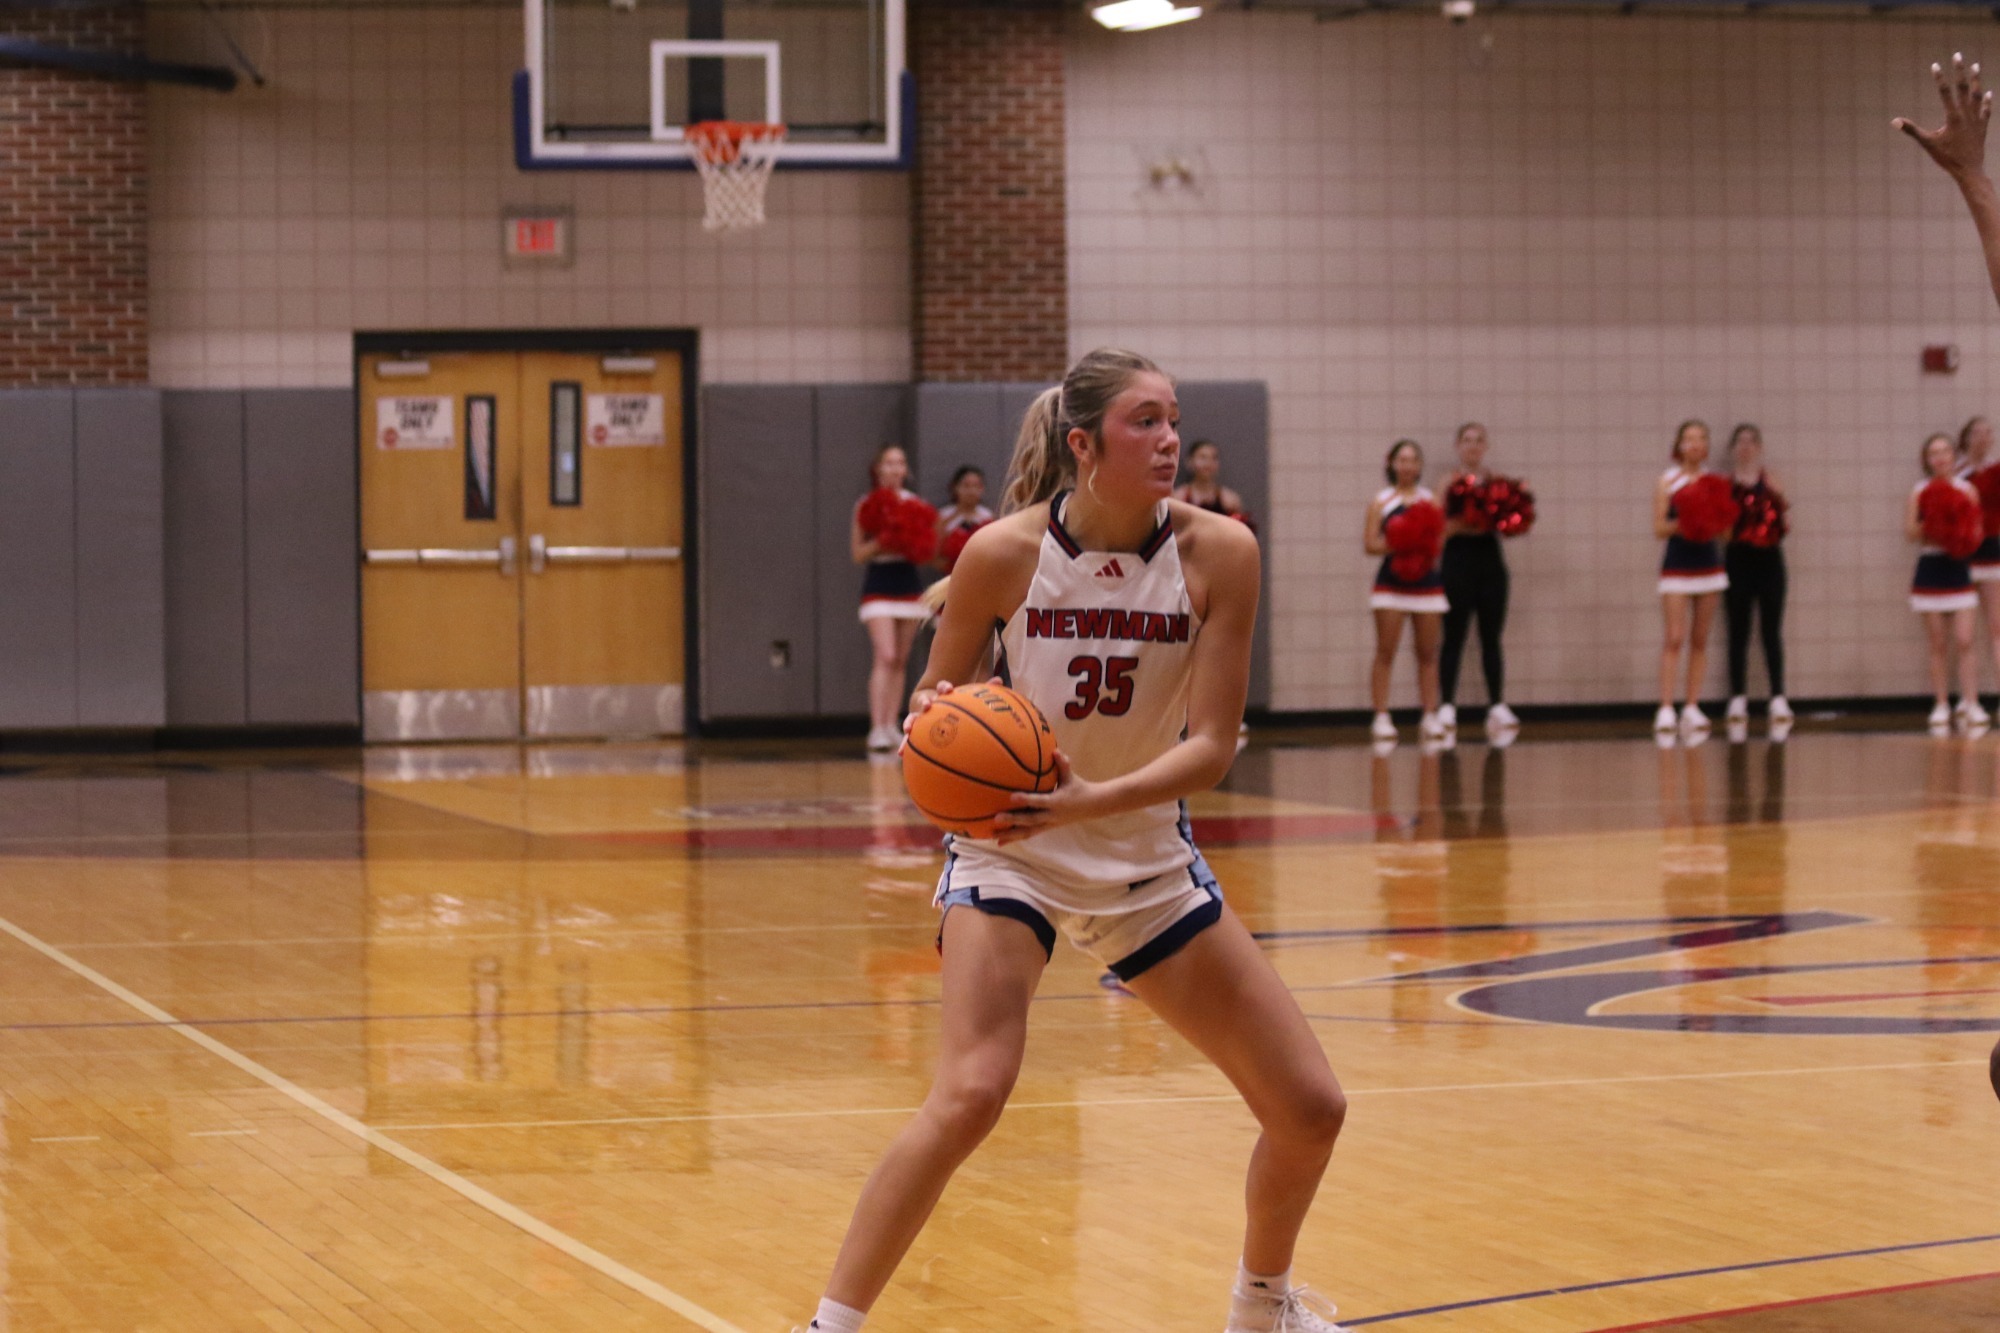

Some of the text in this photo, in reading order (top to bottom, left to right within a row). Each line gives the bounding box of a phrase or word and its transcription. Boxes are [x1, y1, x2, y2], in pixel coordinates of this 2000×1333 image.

[517, 219, 555, 252] EXIT
[401, 413, 434, 430] ONLY
[609, 411, 645, 427] ONLY
[1026, 608, 1190, 643] NEWMAN
[1064, 655, 1139, 721] 35
